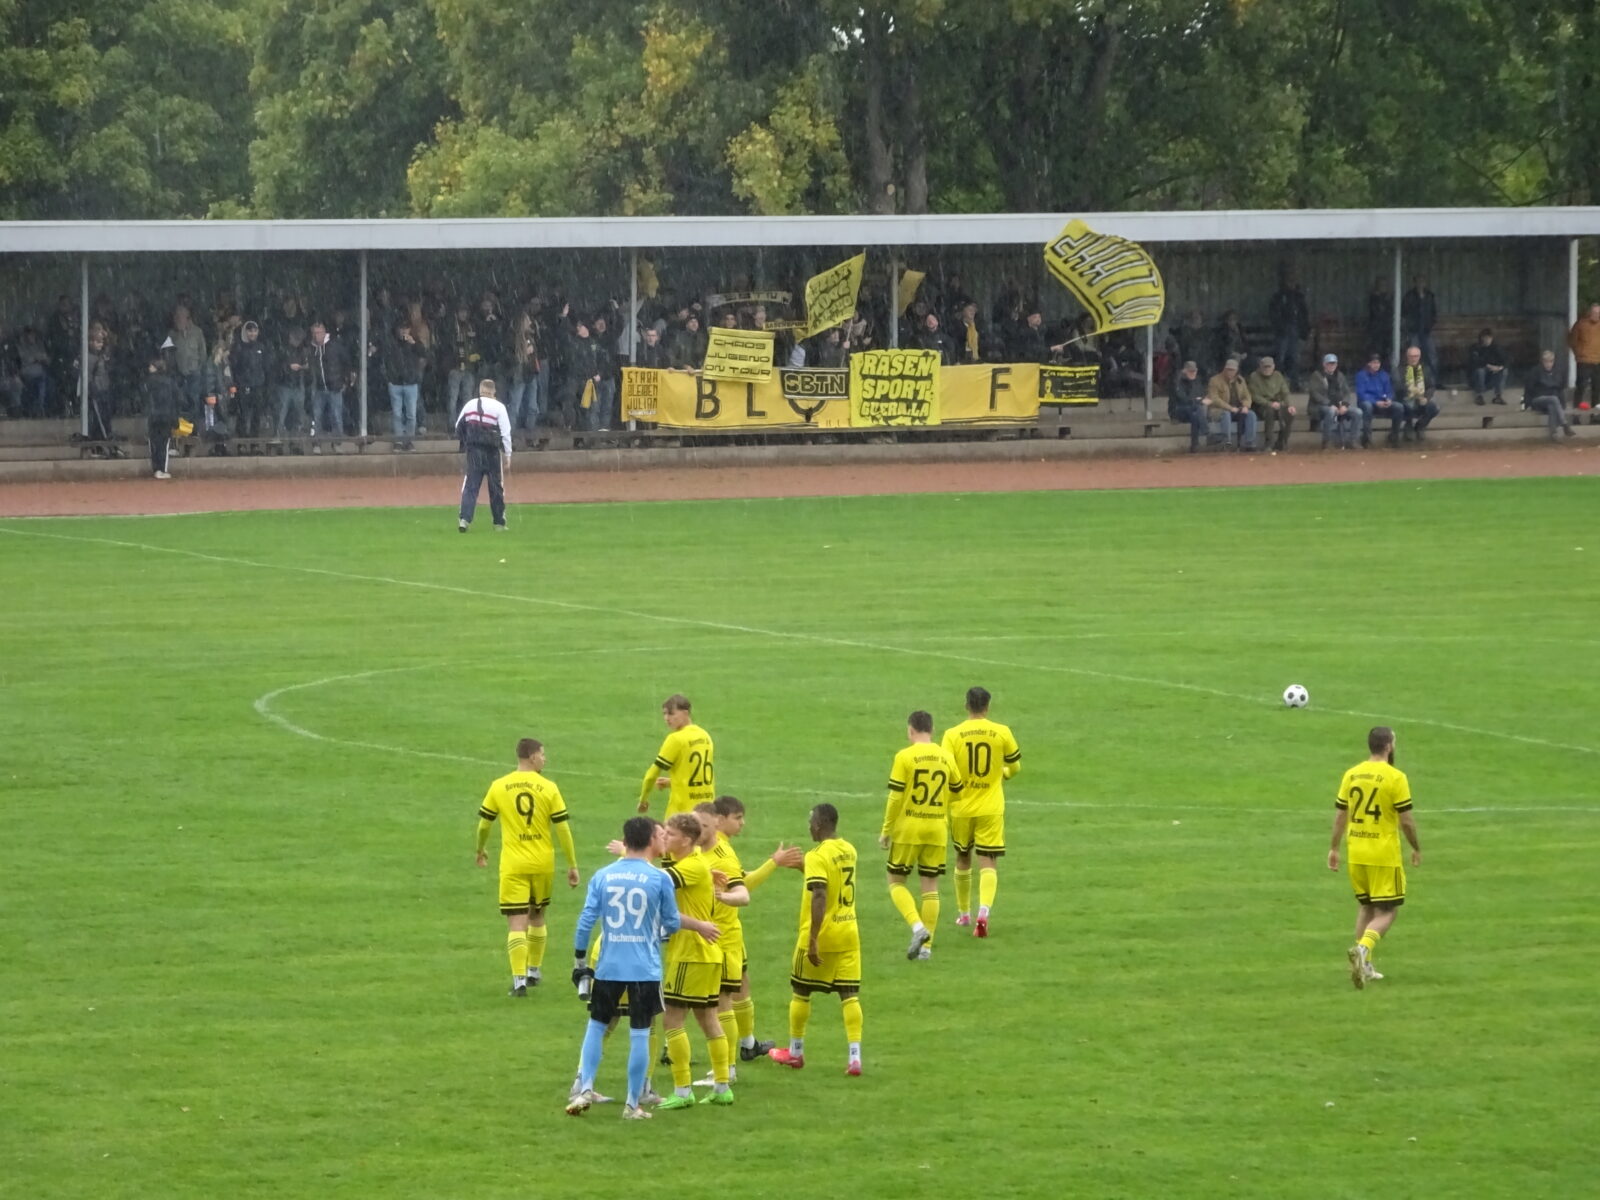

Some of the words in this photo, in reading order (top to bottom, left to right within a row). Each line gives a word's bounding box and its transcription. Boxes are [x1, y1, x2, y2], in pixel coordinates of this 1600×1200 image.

[706, 352, 771, 363] JUGEND
[713, 339, 766, 350] CHAOS
[729, 366, 771, 376] TOUR
[784, 373, 845, 394] SBTN
[860, 353, 934, 379] RASEN
[861, 378, 934, 402] SPORT
[989, 367, 1012, 412] F
[688, 749, 714, 787] 26
[965, 742, 992, 778] 10
[911, 769, 947, 807] 52
[1349, 786, 1382, 825] 24
[515, 791, 535, 829] 9
[605, 886, 648, 930] 39
